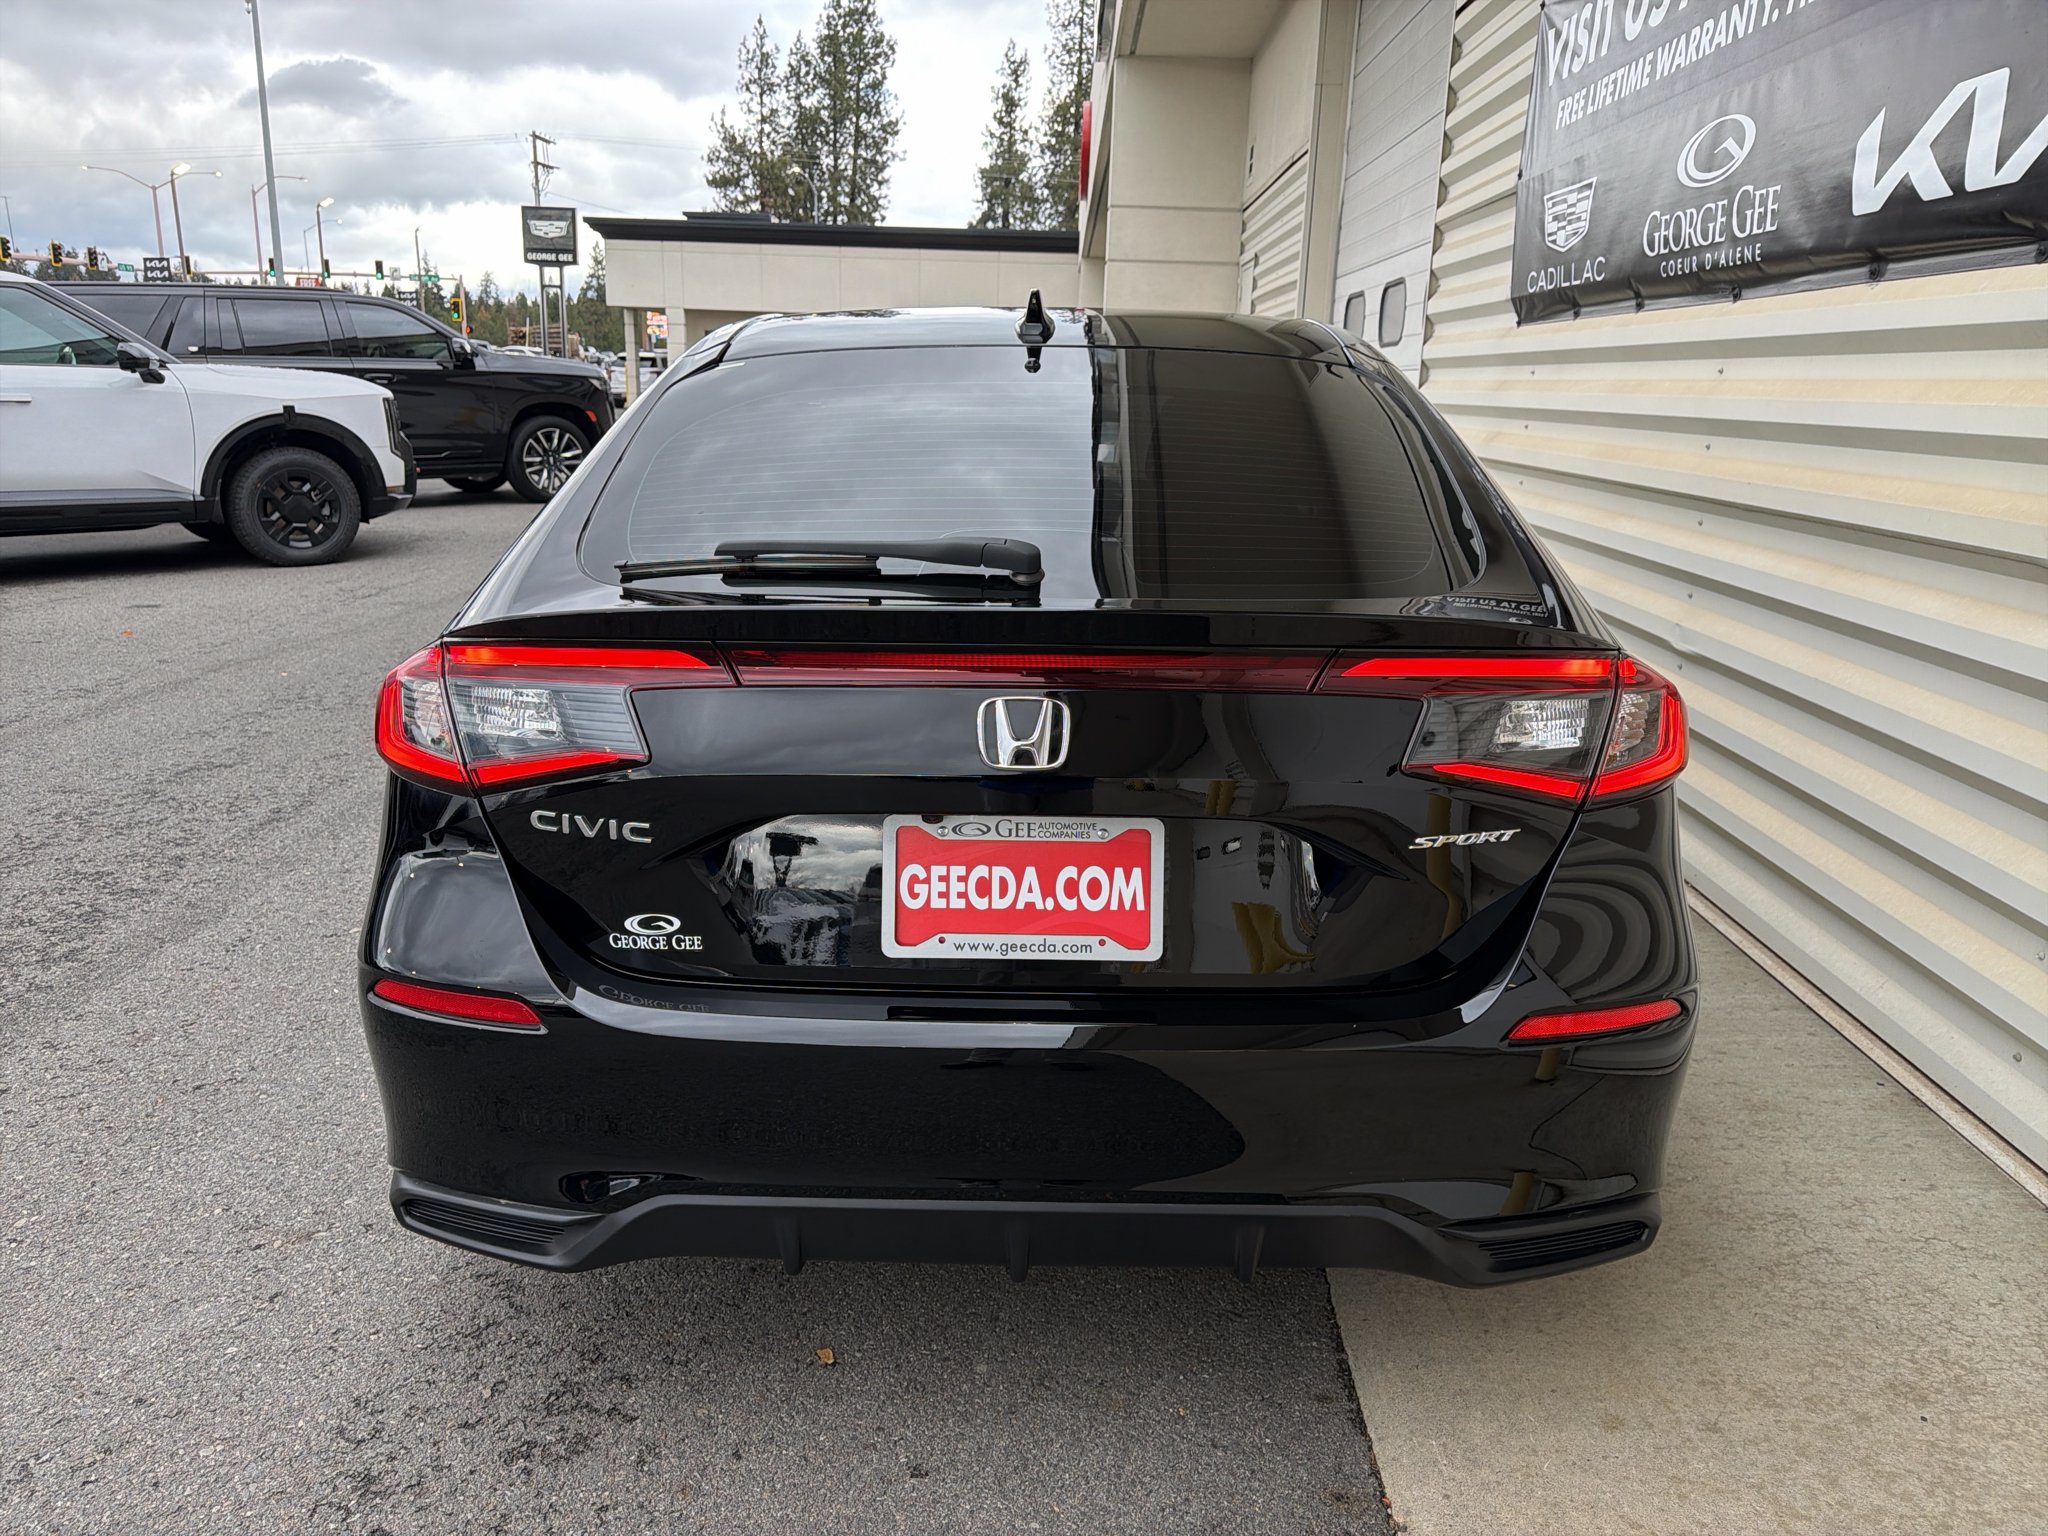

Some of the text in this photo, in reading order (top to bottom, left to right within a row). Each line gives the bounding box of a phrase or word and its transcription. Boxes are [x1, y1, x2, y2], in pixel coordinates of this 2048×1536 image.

[1548, 0, 1614, 87] VISIT
[1555, 0, 1779, 130] FREE LIFETIME WARRANTY.
[1642, 184, 1781, 257] GEORGE GEE
[527, 252, 574, 262] GEORGE GEE
[1660, 243, 1762, 278] COEUR D'ALENE
[1527, 257, 1606, 293] CADILLAC
[530, 810, 655, 844] CIVIC
[995, 818, 1097, 839] GEE AUTOMOTIVE
[1037, 830, 1091, 839] COMPANIES
[1408, 828, 1522, 850] SPORT
[899, 863, 1145, 912] GEECDA.COM
[609, 932, 703, 950] GEORGE GEE
[953, 938, 1093, 957] www.geecda.com
